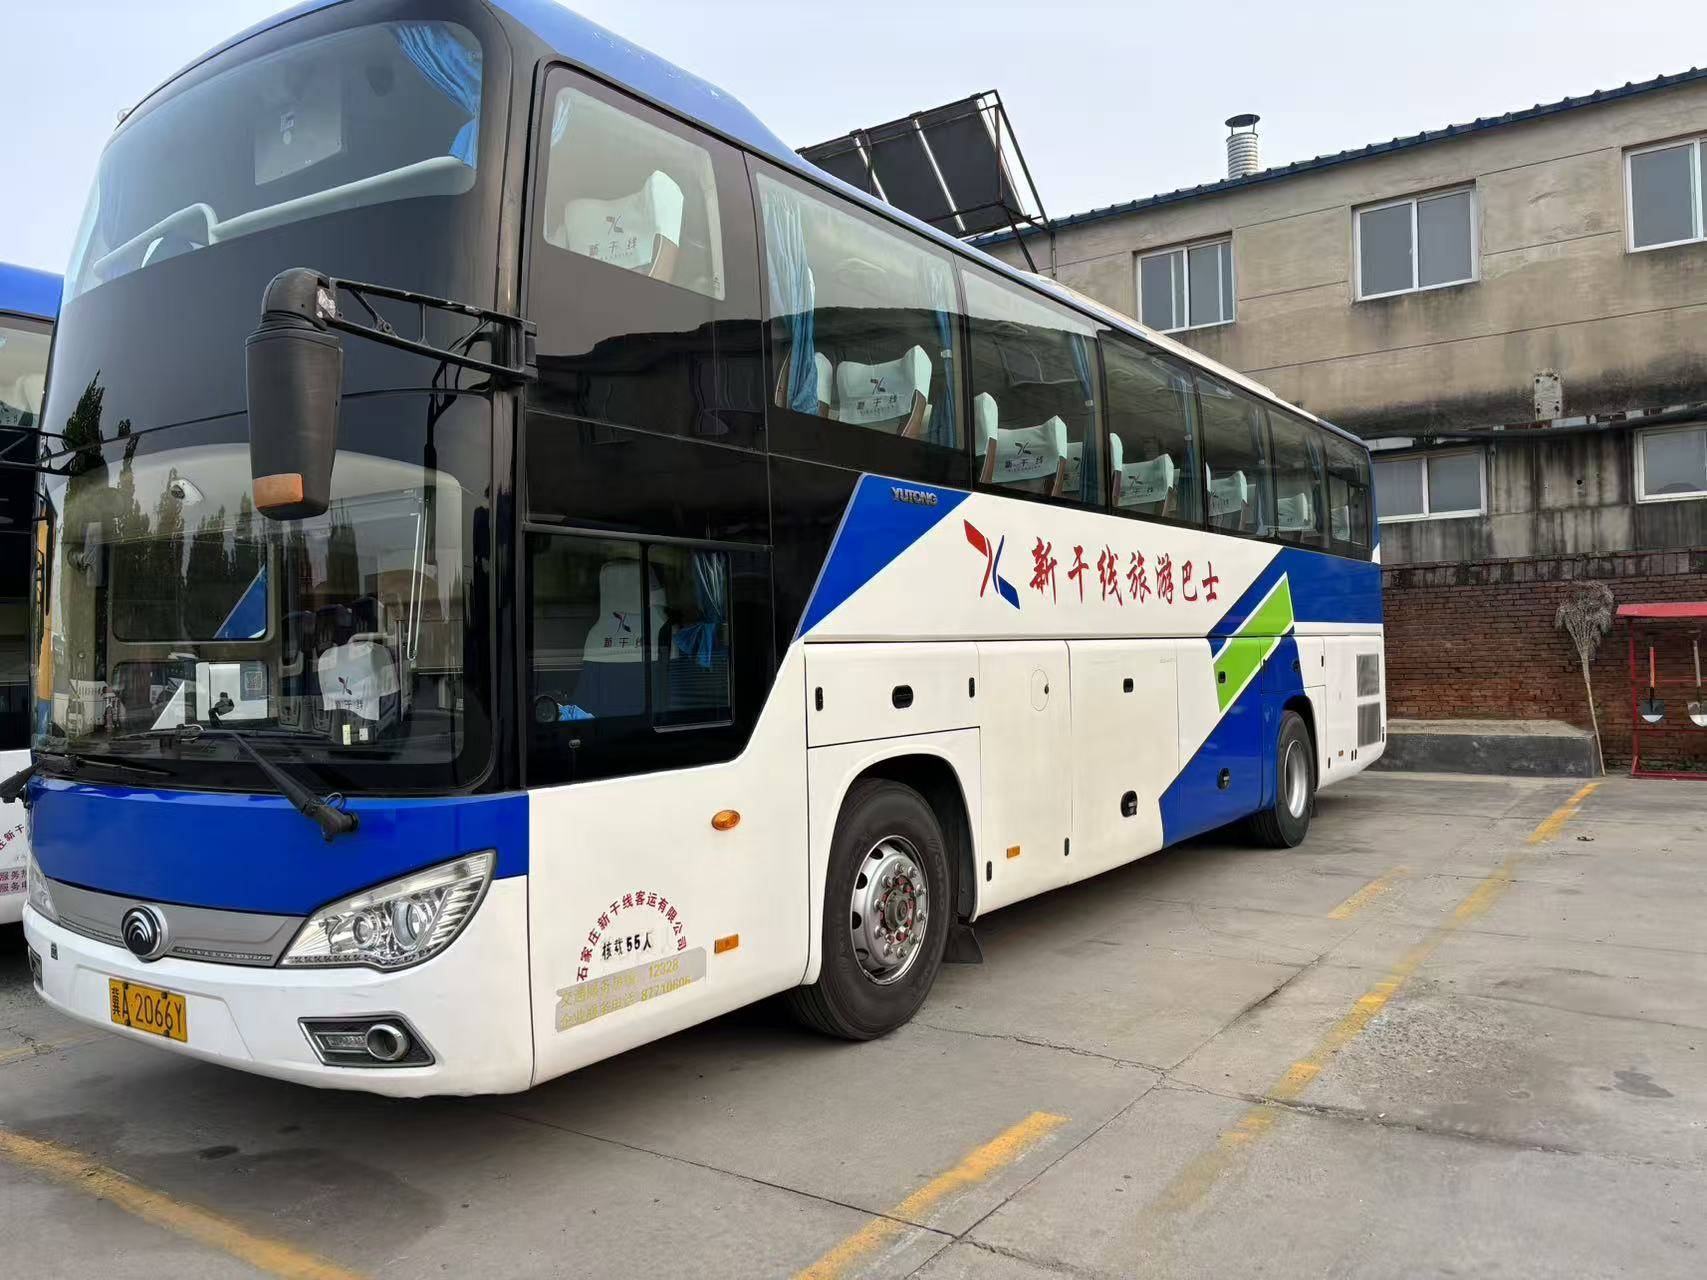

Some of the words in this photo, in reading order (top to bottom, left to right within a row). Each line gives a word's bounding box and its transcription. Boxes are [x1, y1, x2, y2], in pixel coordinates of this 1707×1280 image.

[891, 487, 937, 506] YUTONG
[1029, 536, 1219, 607] 新干线旅游巴士
[576, 890, 687, 981] 石家庄新干线客运有限公司
